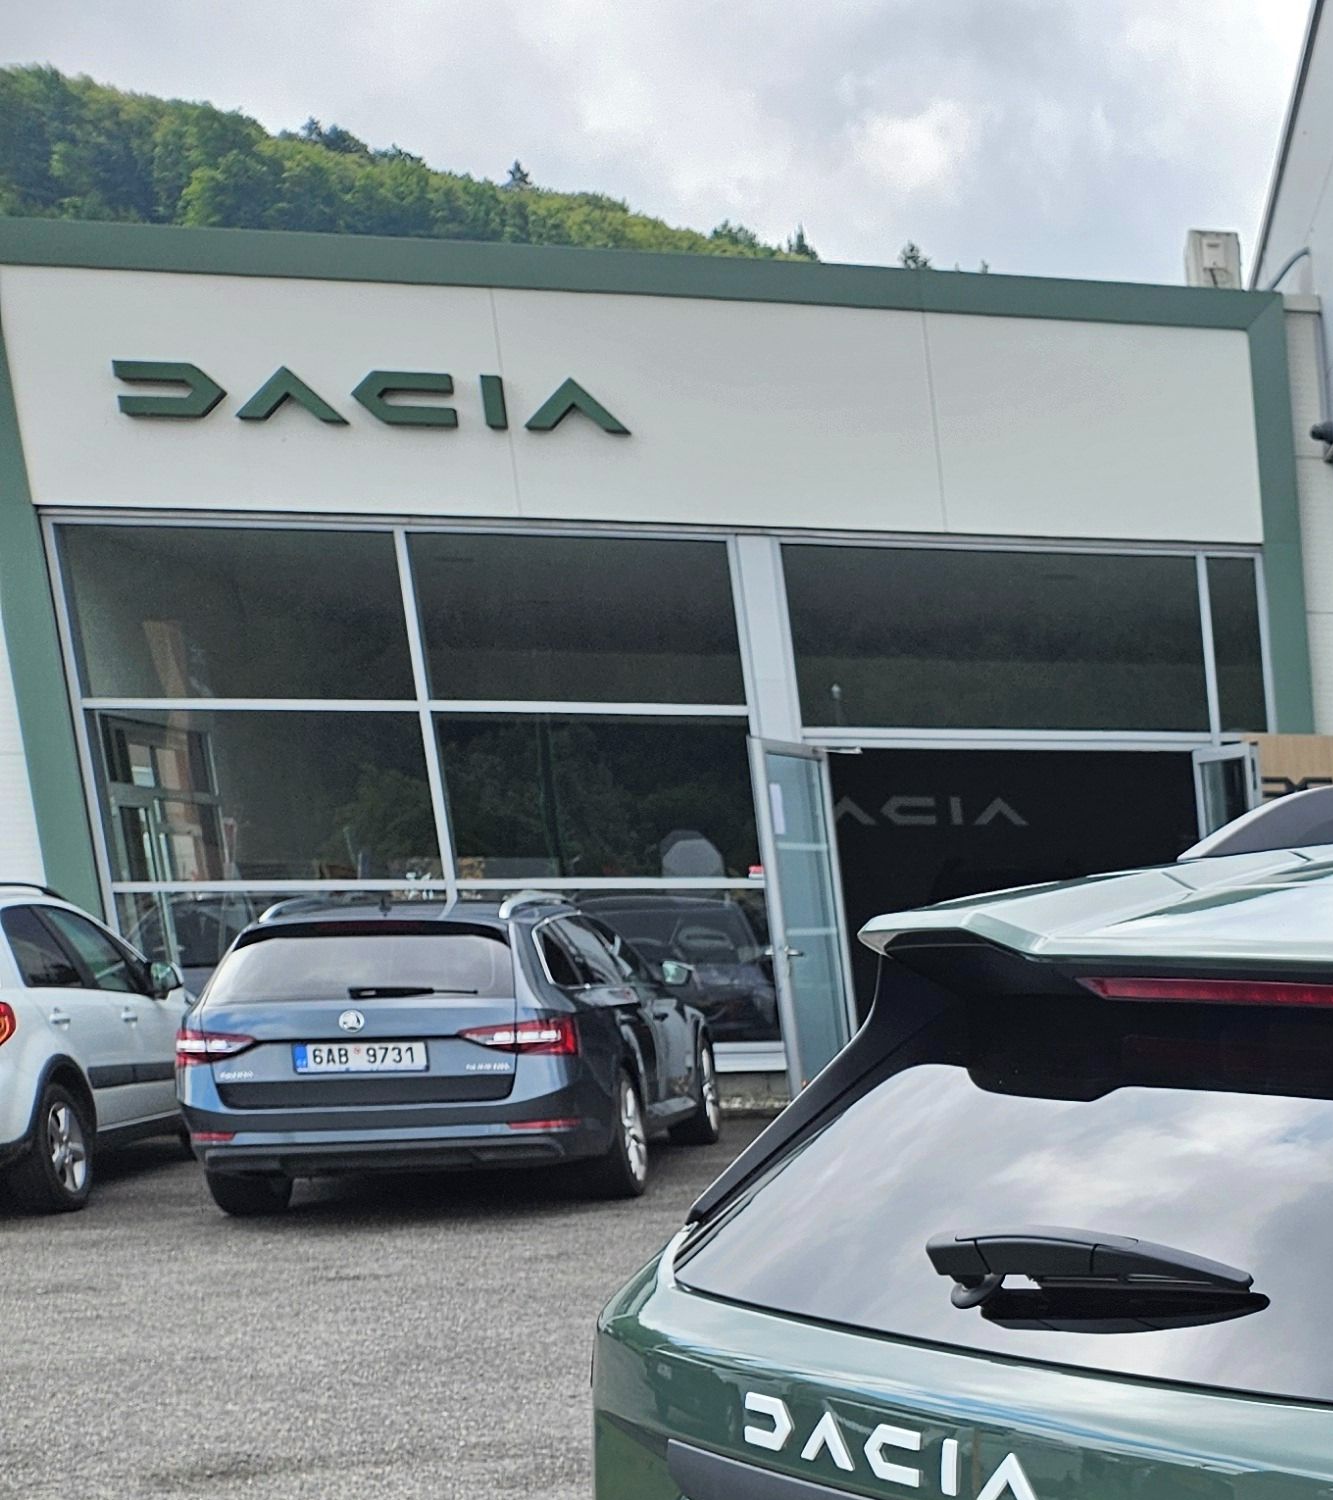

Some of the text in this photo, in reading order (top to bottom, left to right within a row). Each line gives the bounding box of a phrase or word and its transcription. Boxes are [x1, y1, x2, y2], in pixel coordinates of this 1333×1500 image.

[111, 359, 633, 437] DACIA
[834, 797, 1030, 826] ACIA
[312, 1046, 415, 1066] 6AB 9731
